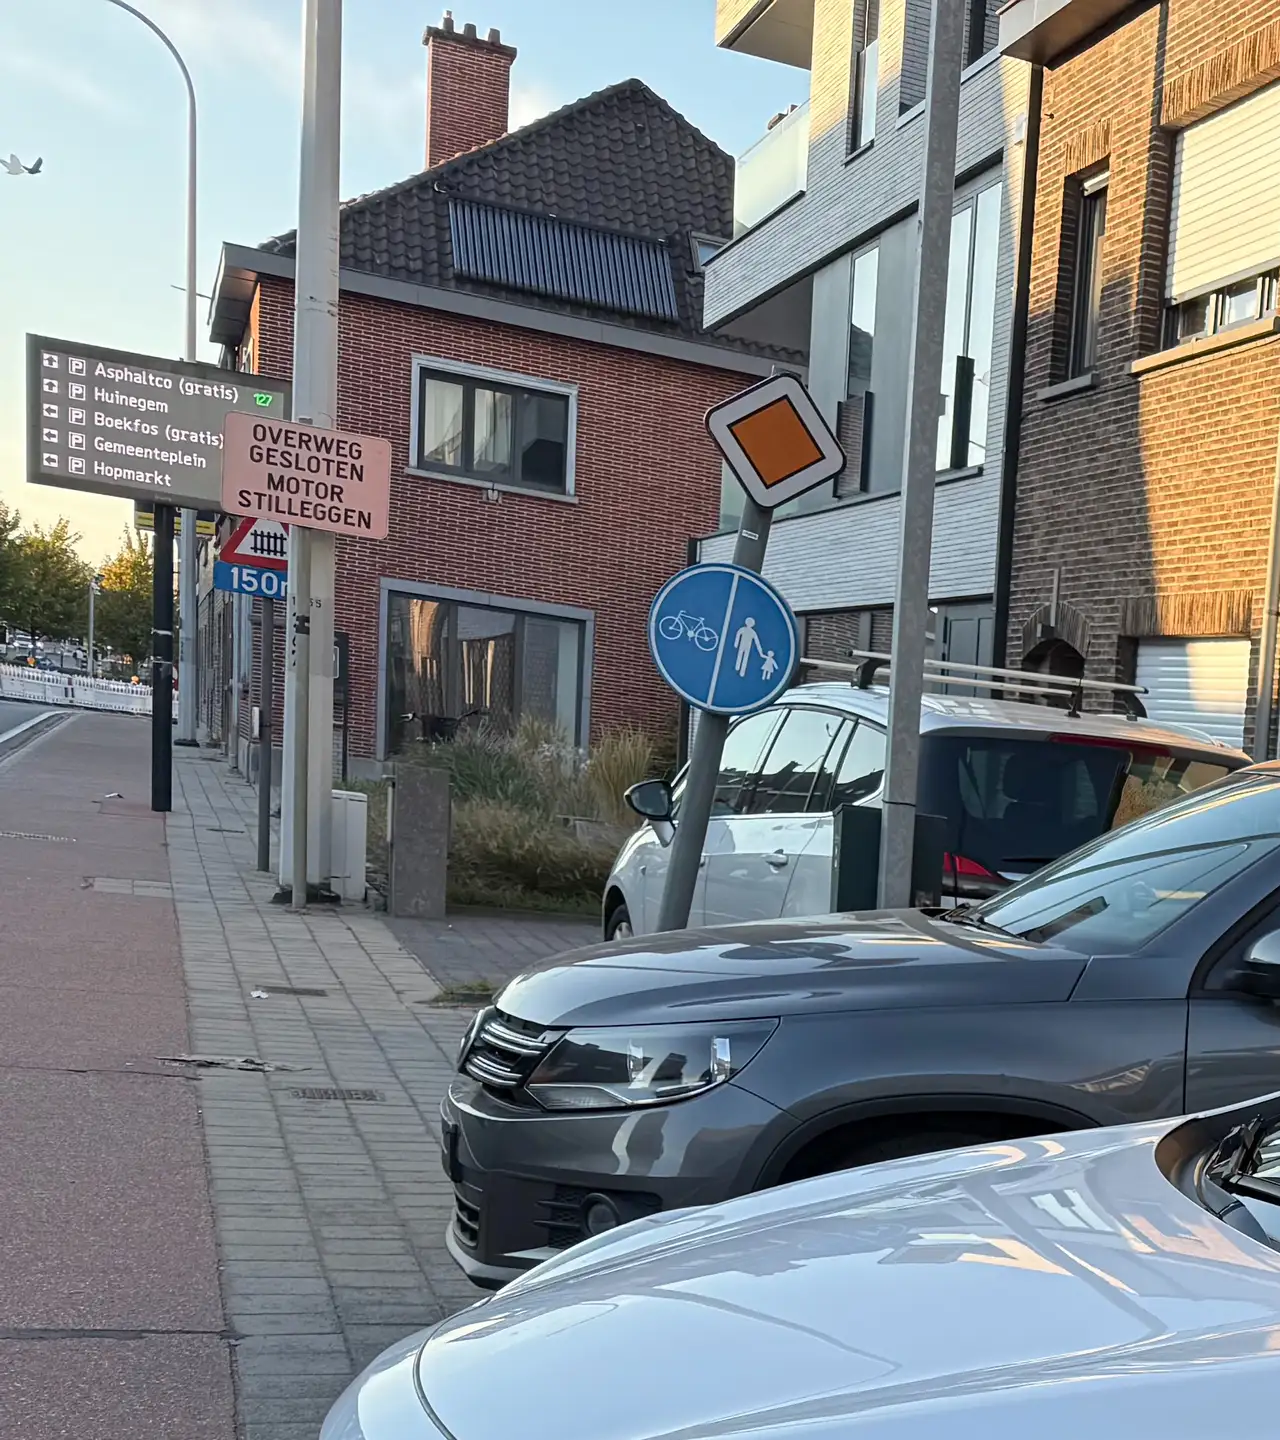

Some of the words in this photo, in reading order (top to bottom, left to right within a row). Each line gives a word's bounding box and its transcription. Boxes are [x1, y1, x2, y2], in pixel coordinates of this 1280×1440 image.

[94, 362, 173, 390] Asphaltco
[178, 377, 239, 404] (gratis)
[94, 387, 169, 414] Huinegem
[94, 411, 159, 436] Boekfos
[165, 424, 224, 450] (gratis)
[252, 422, 362, 461] OVERWEG
[94, 436, 207, 469] Gemeenteplein
[249, 444, 364, 483] GESLOTEN
[94, 460, 172, 487] Hopmarkt
[267, 472, 344, 503] MOTOR
[238, 489, 372, 530] STILLEGGEN
